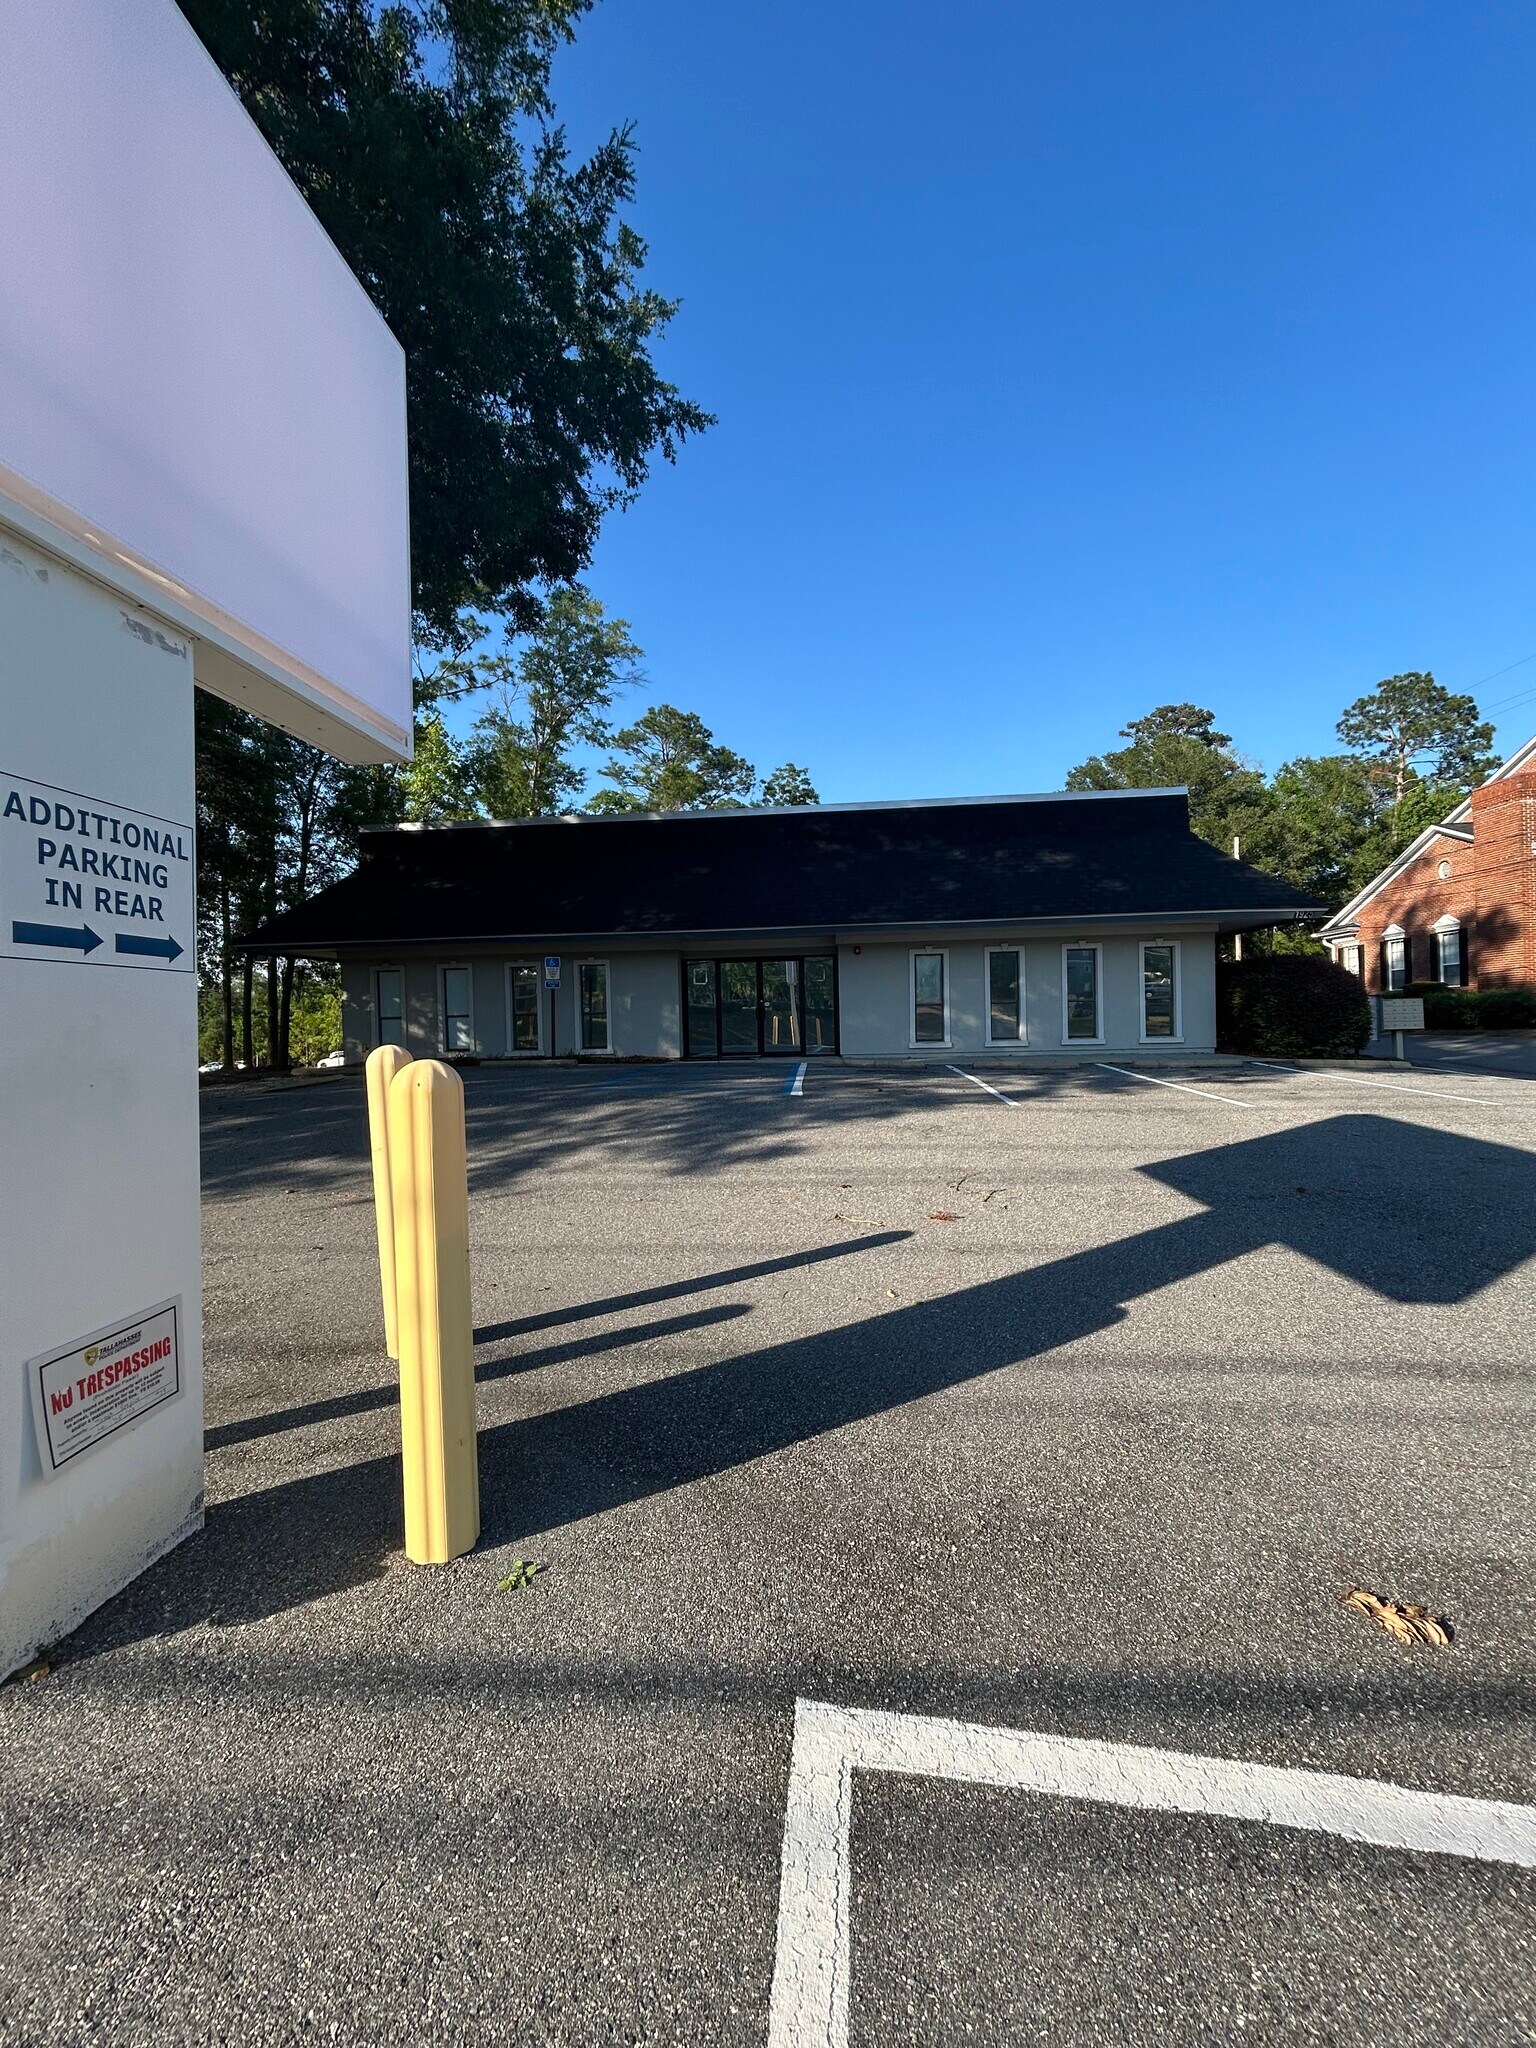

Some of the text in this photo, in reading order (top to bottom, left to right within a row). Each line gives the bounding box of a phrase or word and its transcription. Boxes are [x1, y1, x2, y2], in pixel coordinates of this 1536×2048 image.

[3, 791, 189, 861] ADDITIONAL
[38, 837, 168, 889] PARKING
[45, 877, 164, 922] IN REAR
[99, 1330, 142, 1354] TALLAHASSEE
[77, 1337, 171, 1401] TRESPASSING
